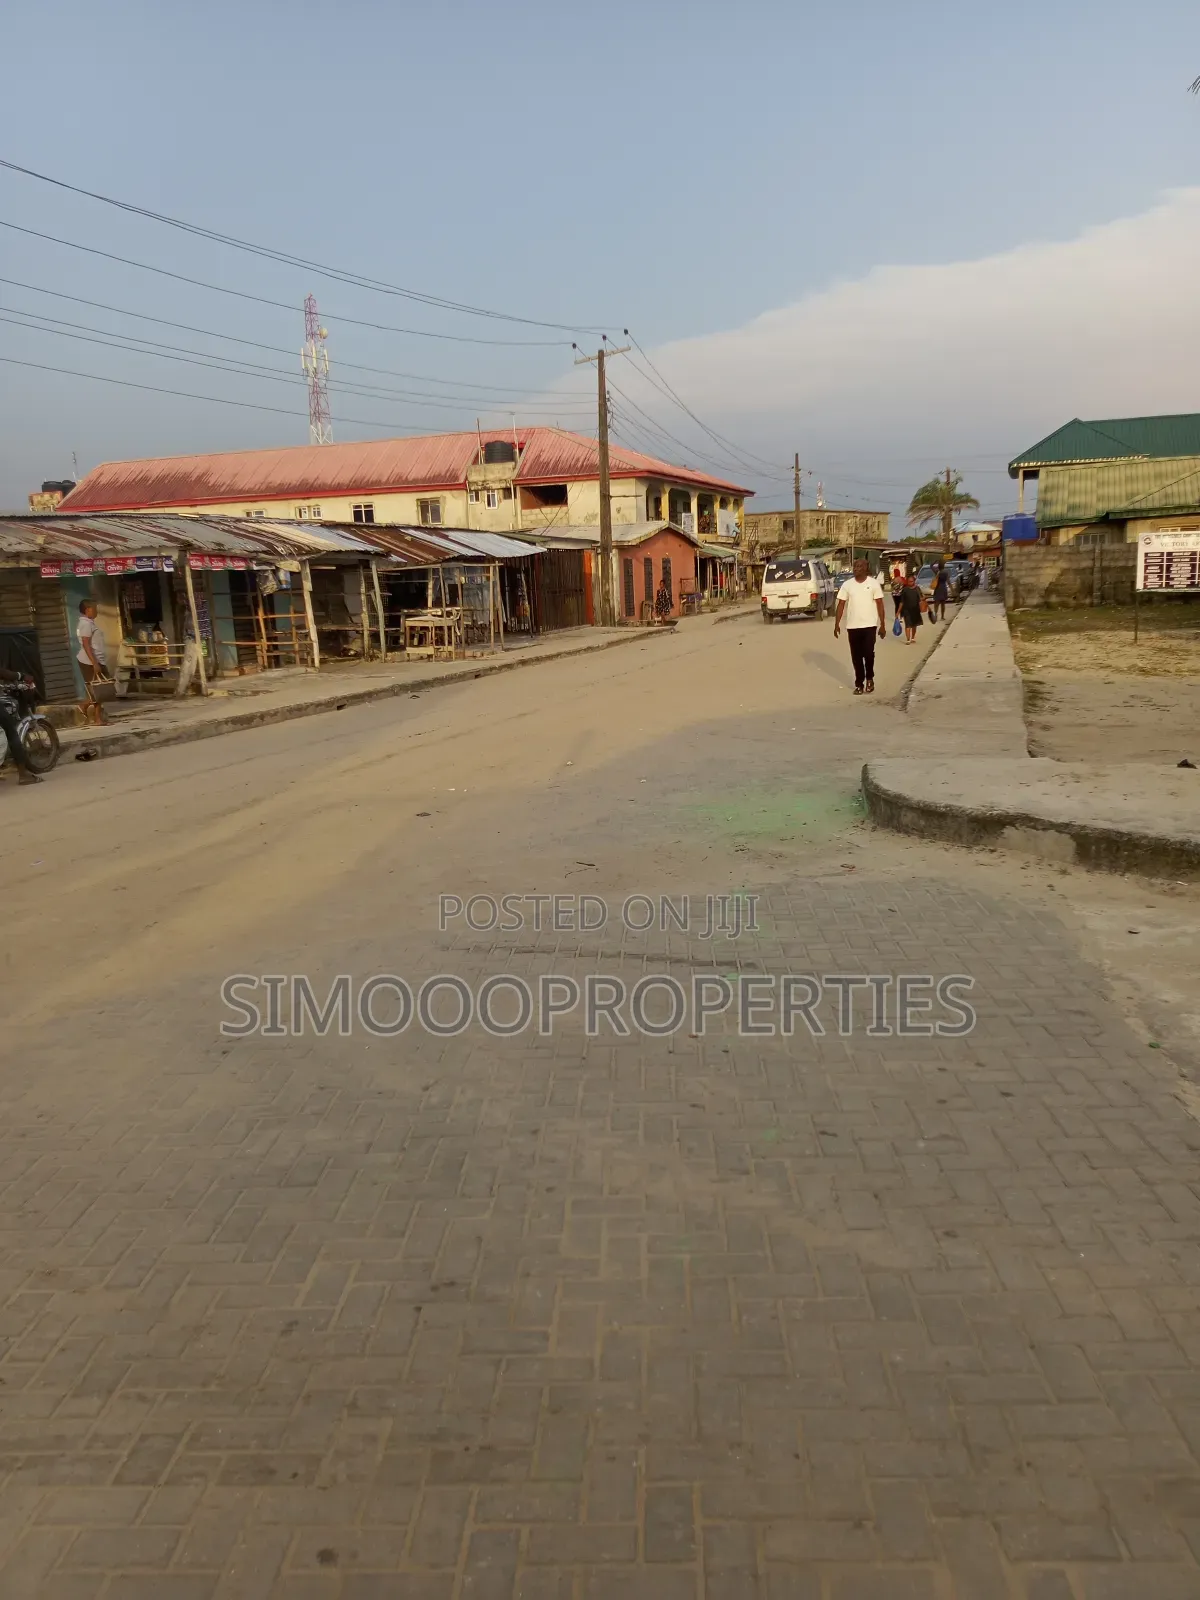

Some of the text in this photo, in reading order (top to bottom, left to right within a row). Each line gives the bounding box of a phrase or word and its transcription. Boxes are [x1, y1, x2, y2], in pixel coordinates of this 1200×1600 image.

[41, 565, 60, 574] Chivita
[76, 564, 93, 573] Chivita
[107, 563, 123, 571] Chivita
